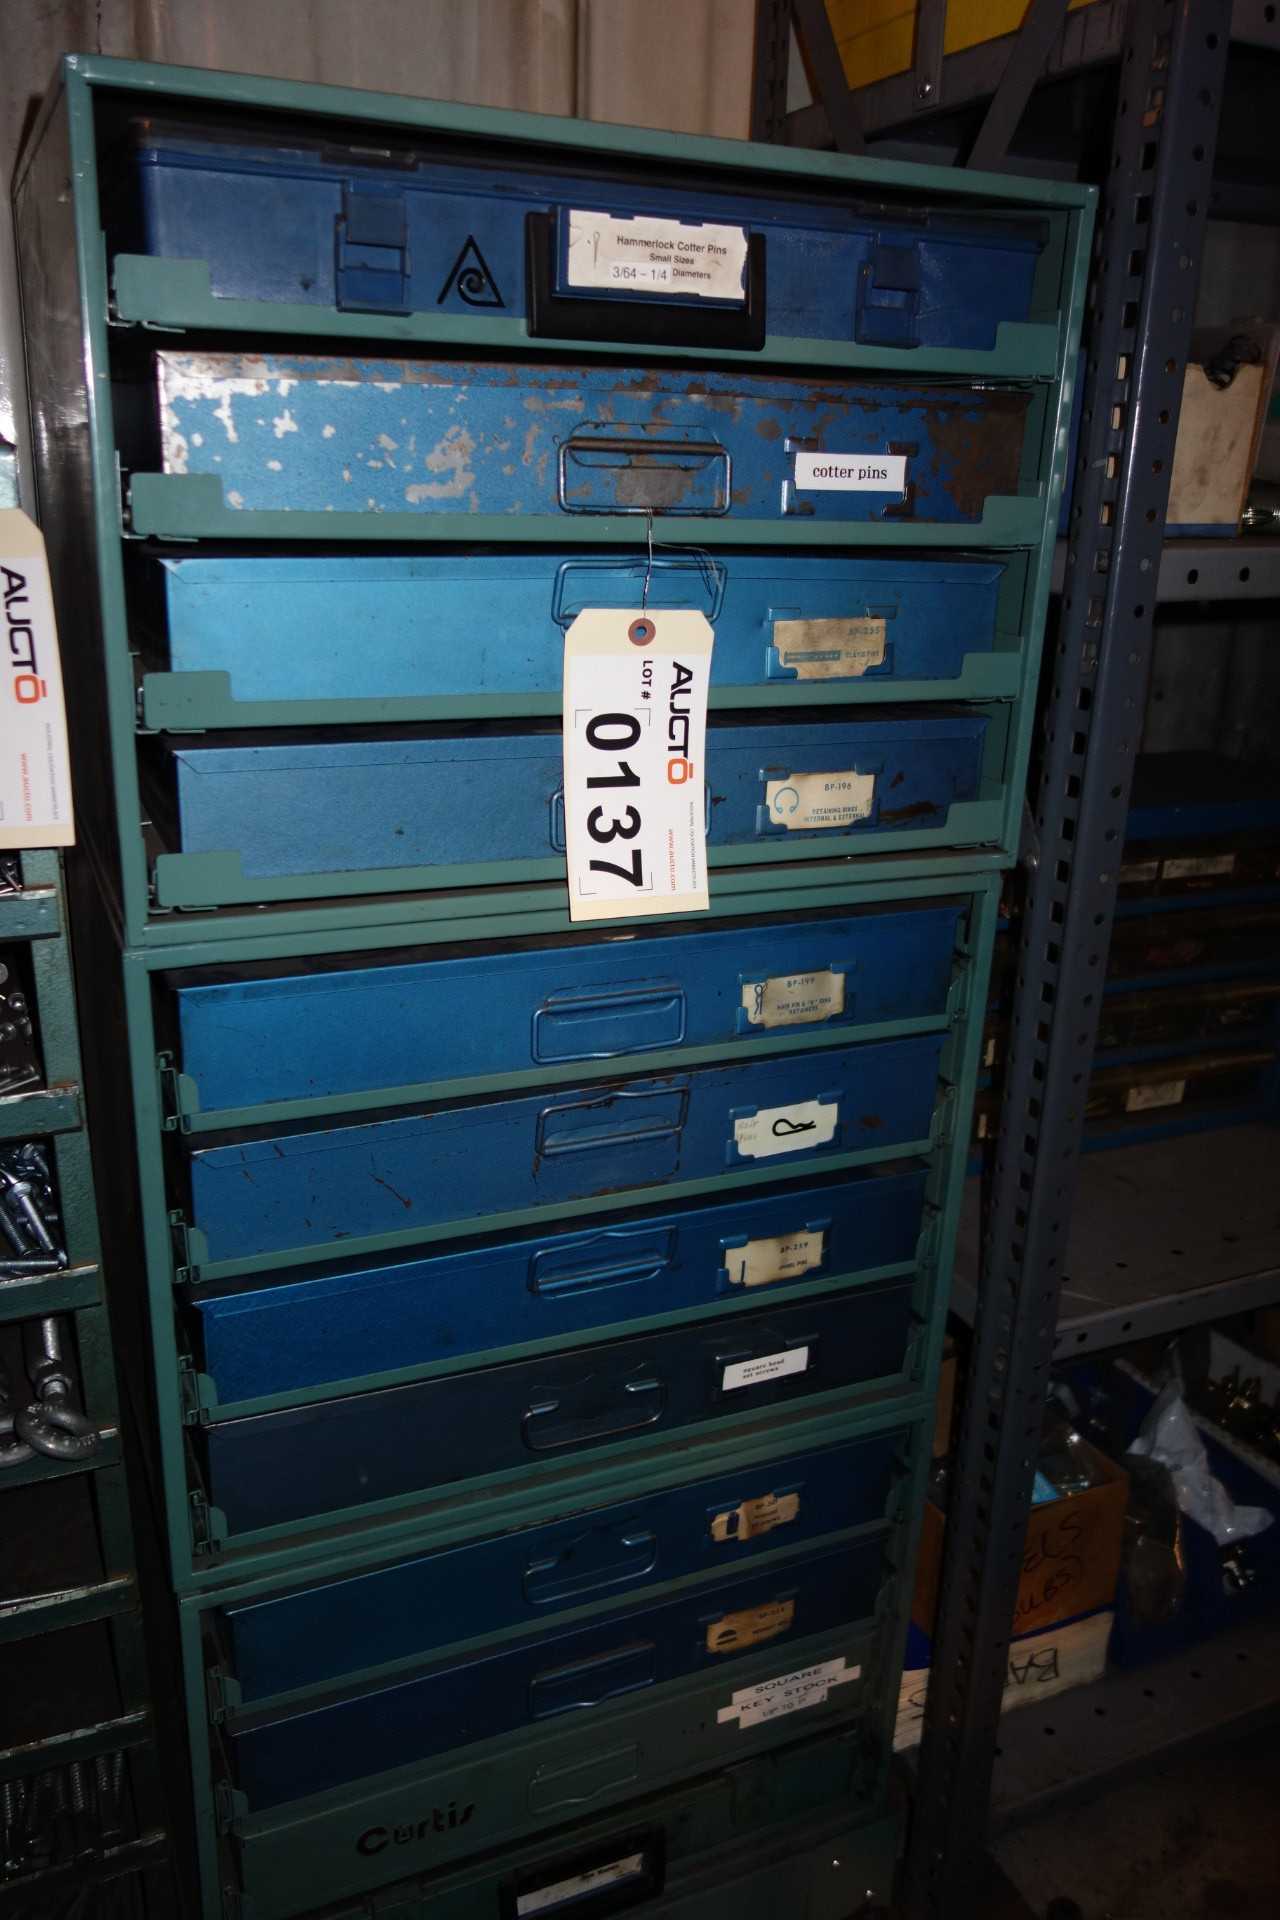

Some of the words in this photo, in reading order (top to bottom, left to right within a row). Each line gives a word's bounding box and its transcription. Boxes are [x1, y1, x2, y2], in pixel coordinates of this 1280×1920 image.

[617, 235, 674, 250] Hammerlock
[678, 242, 705, 253] Cotter
[707, 244, 727, 255] Pins
[650, 253, 671, 263] Small
[673, 256, 694, 265] Sizes
[612, 266, 637, 279] 3/64
[651, 268, 667, 280] 1/4
[673, 268, 711, 279] Diameters
[813, 466, 854, 478] cotter
[858, 466, 887, 480] pins
[642, 660, 653, 686] LOT
[641, 690, 652, 700] #
[586, 712, 643, 887] 0137
[754, 1667, 823, 1694] SQUARE
[741, 1695, 775, 1711] KEY
[784, 1677, 838, 1697] STOCK
[356, 1802, 475, 1857] Curtis
